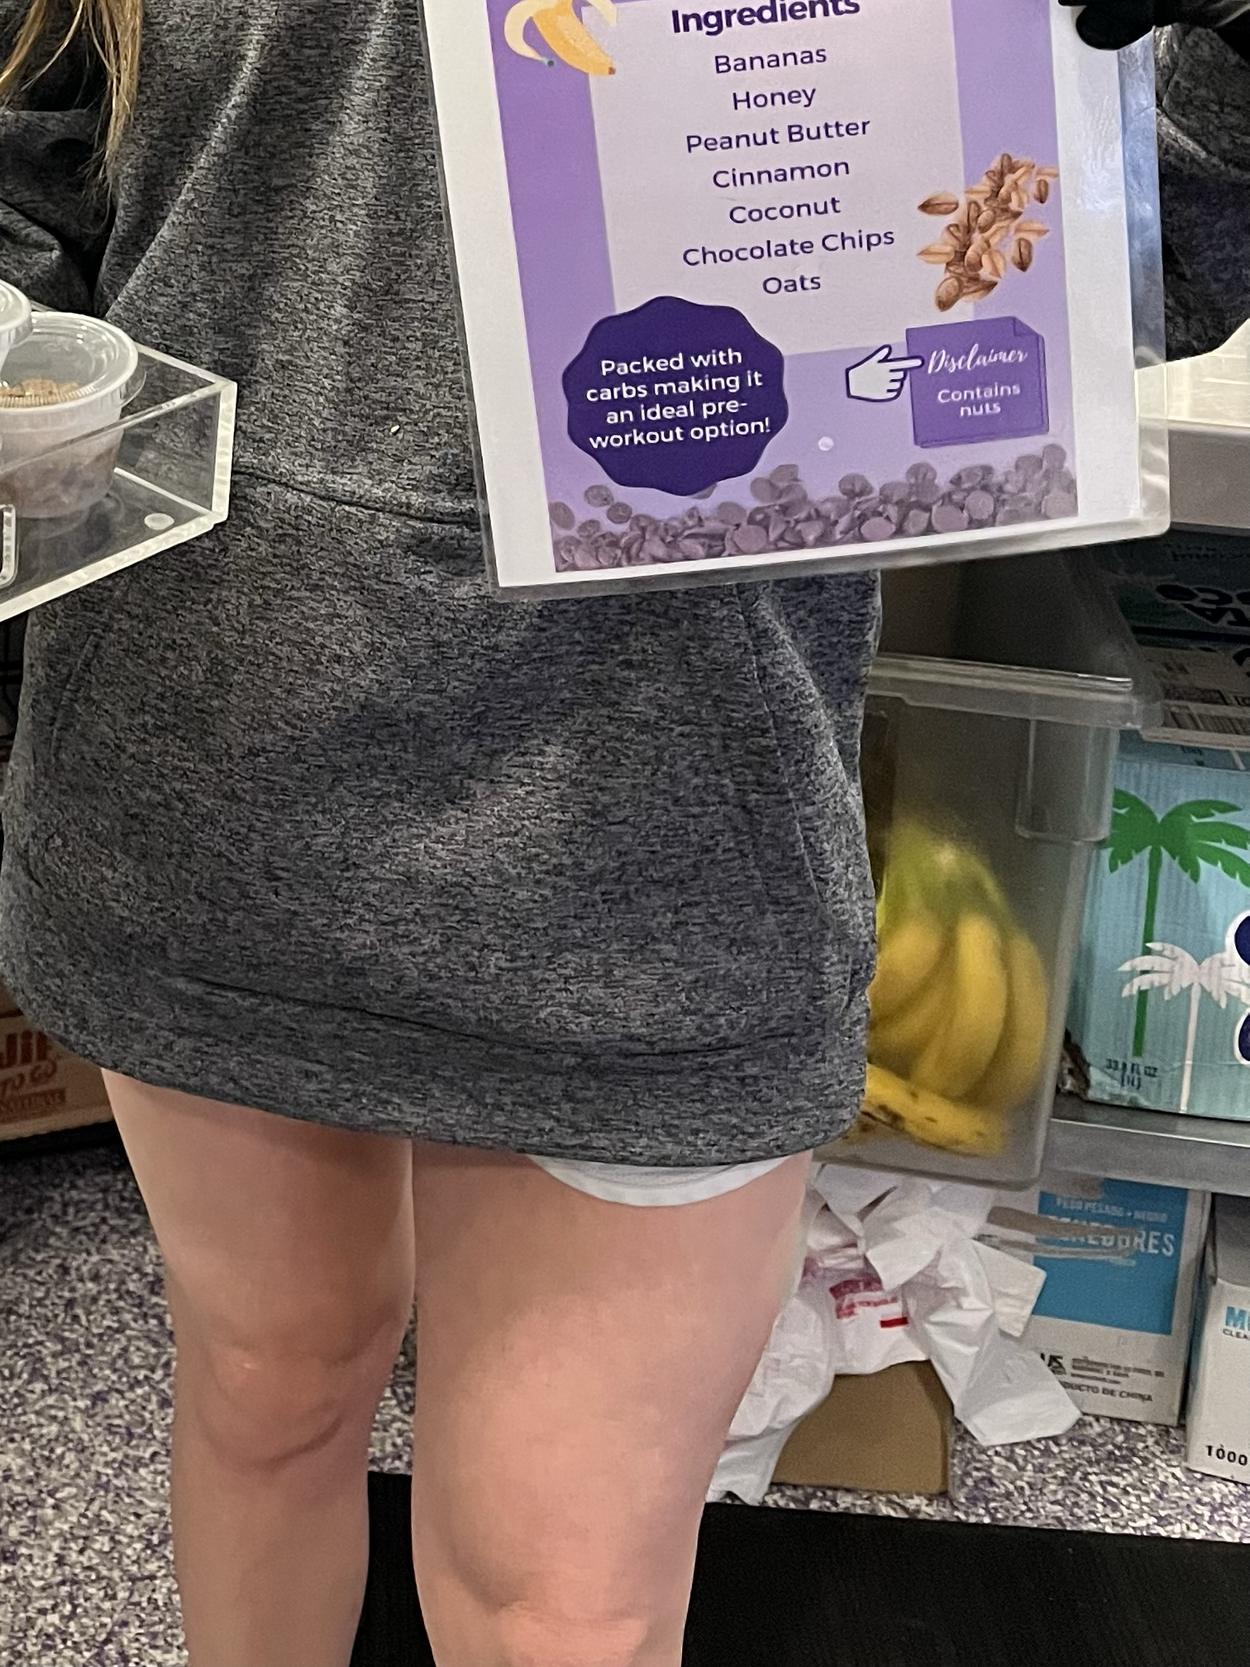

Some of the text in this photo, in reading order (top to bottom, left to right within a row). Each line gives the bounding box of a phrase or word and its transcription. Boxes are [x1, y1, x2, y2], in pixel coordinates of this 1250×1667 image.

[714, 48, 827, 74] Bananas
[732, 87, 817, 110] Honey
[686, 120, 870, 153] Peanut Butter
[712, 161, 850, 188] Cinnamon
[729, 197, 841, 224] Coconut
[682, 229, 895, 266] Chocolate Chips
[762, 275, 821, 295] Oats
[601, 348, 743, 376] Packed with
[928, 343, 1028, 374] Disclaimer
[586, 370, 763, 402] carbs making it
[937, 382, 1021, 403] Contains
[606, 399, 748, 424] an ideal pre-
[960, 402, 1001, 417] nuts
[589, 417, 771, 449] workout option!
[1102, 1387, 1116, 1397] DE
[1205, 1445, 1248, 1466] 1000
